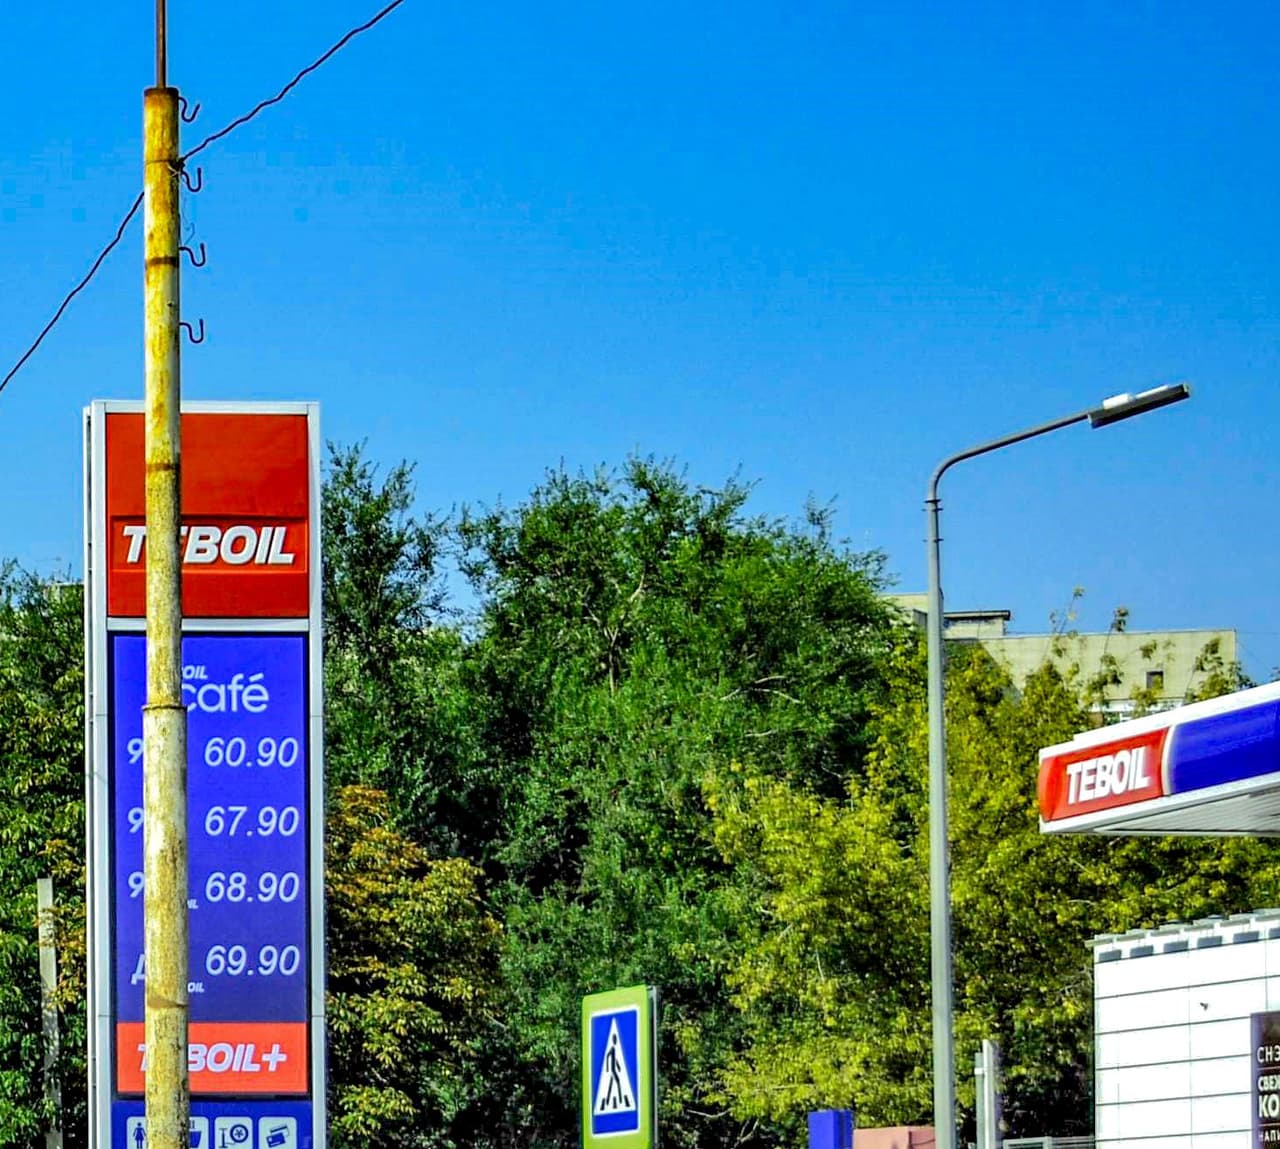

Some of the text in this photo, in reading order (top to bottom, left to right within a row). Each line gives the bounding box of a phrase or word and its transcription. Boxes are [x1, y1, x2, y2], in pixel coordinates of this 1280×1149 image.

[123, 525, 295, 565] TBOIL
[204, 737, 299, 767] 60.90
[1066, 745, 1151, 806] TEBOIL
[204, 806, 300, 837] 67.90
[205, 871, 300, 902] 68.90
[205, 945, 300, 976] 69.90
[137, 1043, 288, 1072] BOIL+
